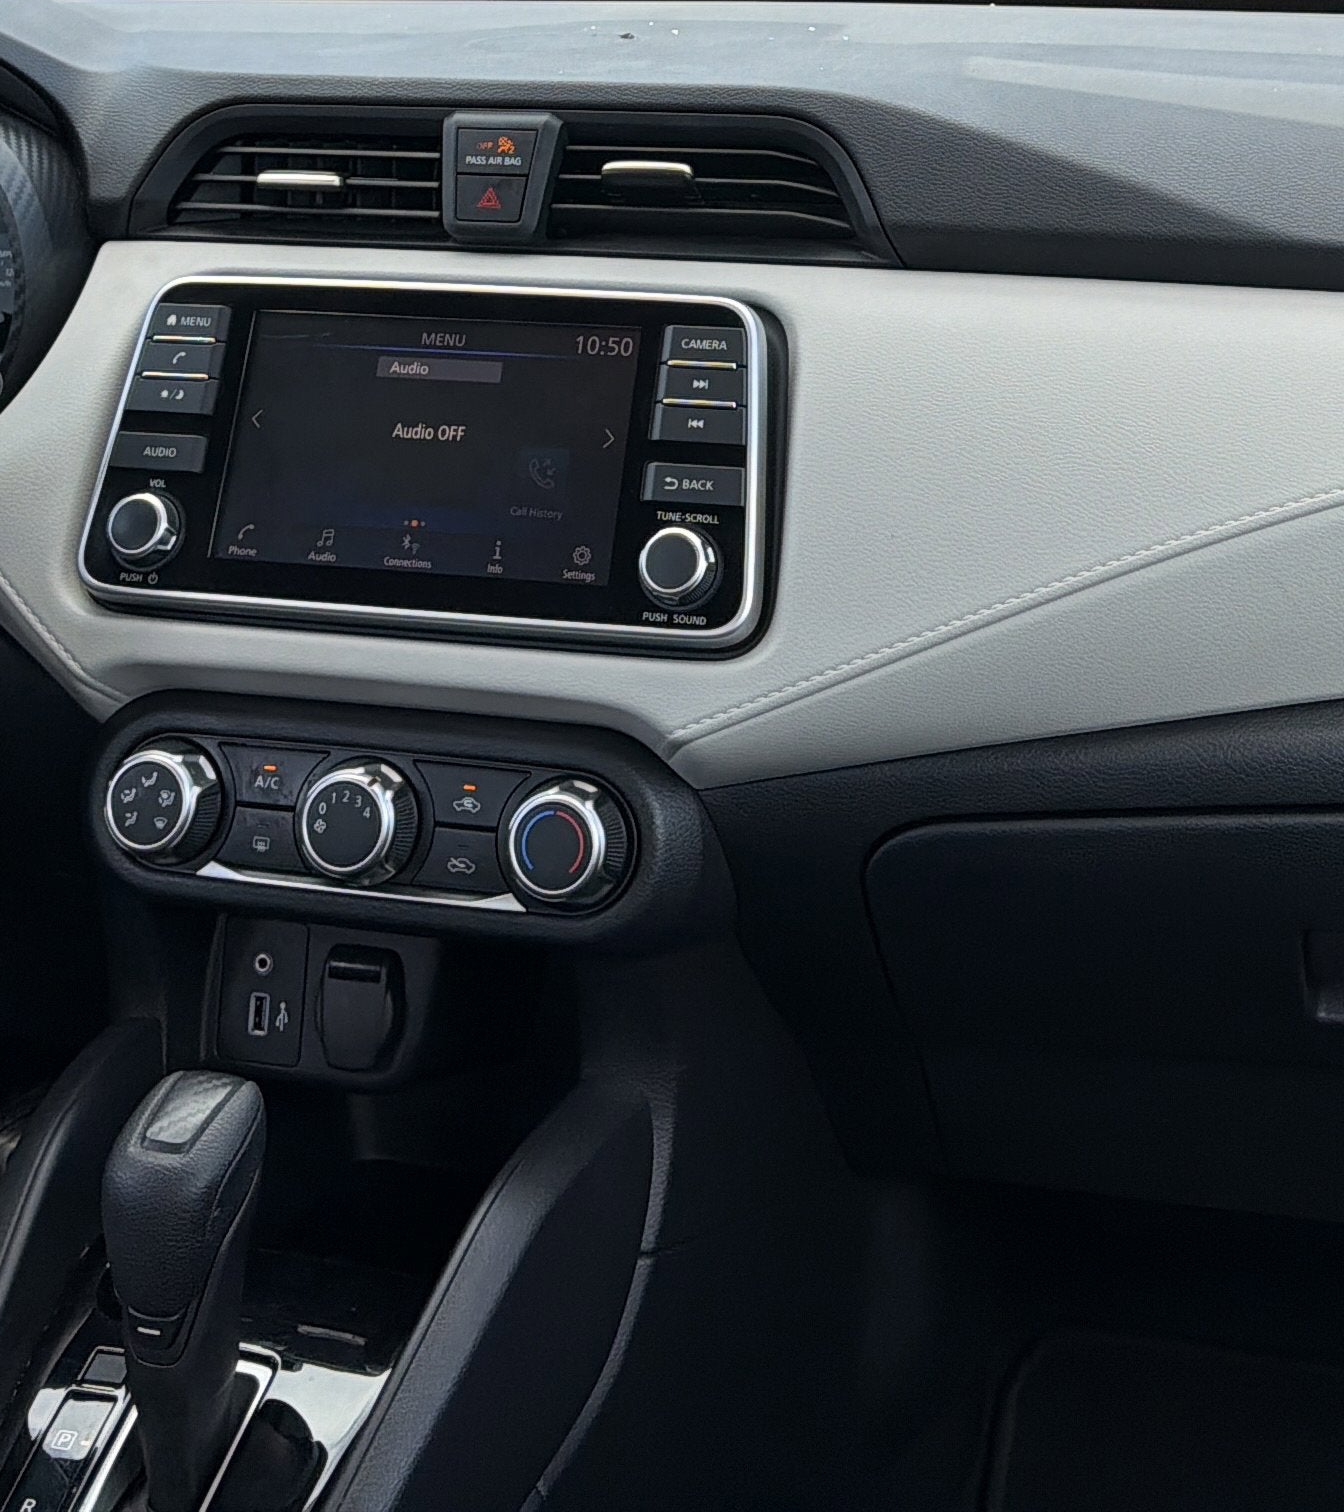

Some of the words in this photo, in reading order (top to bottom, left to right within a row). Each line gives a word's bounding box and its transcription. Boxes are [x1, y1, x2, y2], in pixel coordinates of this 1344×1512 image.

[465, 155, 486, 165] PASS
[487, 156, 503, 165] AIR
[504, 157, 522, 166] BAG
[181, 316, 212, 327] MENU
[421, 332, 466, 347] MENU
[575, 335, 633, 357] 10:50
[681, 338, 727, 350] CAMERA
[389, 361, 429, 375] Audio
[392, 423, 434, 440] Audio
[438, 425, 466, 441] OFF
[143, 446, 177, 458] AUDIO
[149, 478, 167, 488] VOL
[682, 479, 714, 491] BACK
[510, 506, 527, 517] Call
[529, 507, 563, 521] History
[228, 545, 257, 557] Phone
[307, 551, 336, 563] Audio
[384, 556, 432, 570] Connections
[487, 563, 503, 574] Info
[120, 572, 143, 582] PUSH
[563, 569, 596, 583] Settings
[642, 611, 668, 623] PUSH
[673, 614, 707, 626] SOUND
[254, 775, 280, 789] A/C
[331, 792, 337, 804] 1
[342, 790, 350, 803] 2
[354, 795, 362, 808] 3
[318, 802, 327, 815] 0
[363, 806, 371, 819] 4
[57, 1433, 72, 1446] P
